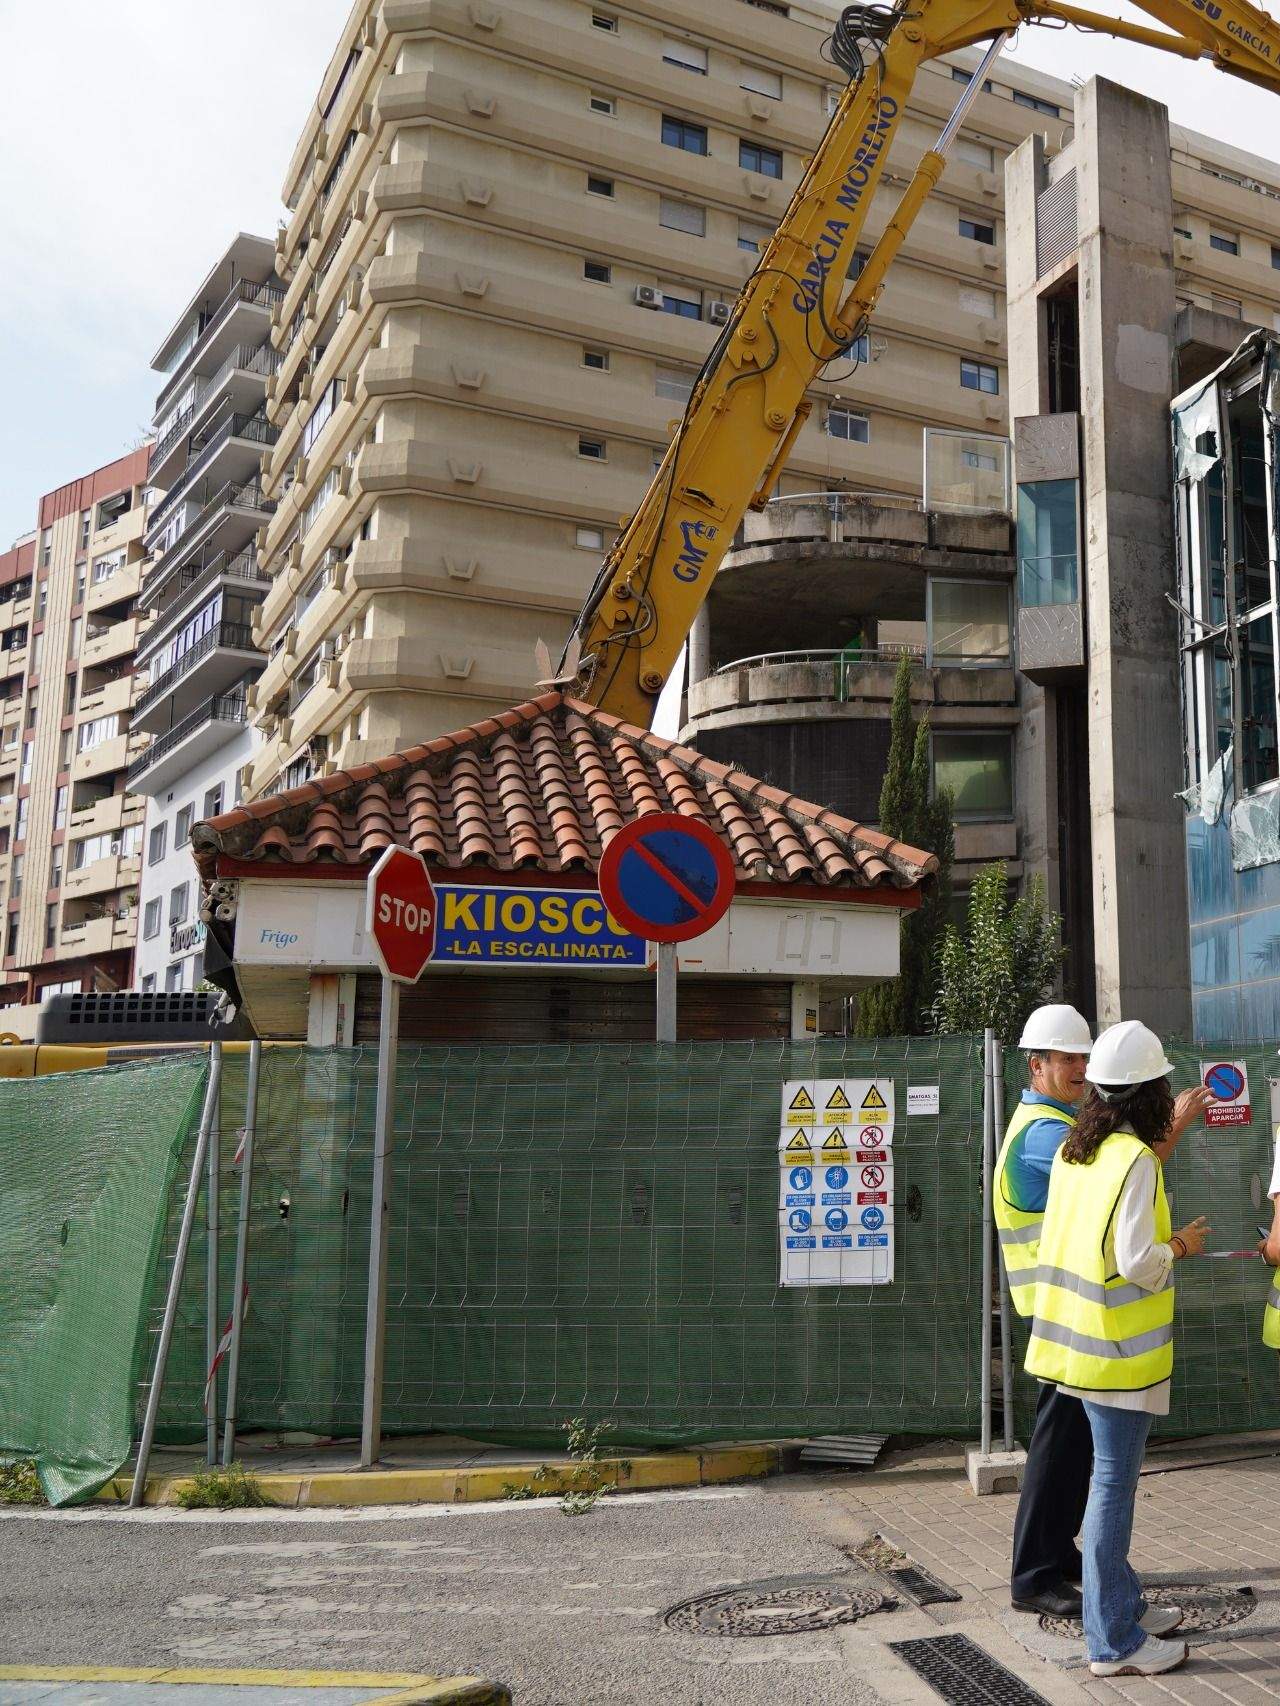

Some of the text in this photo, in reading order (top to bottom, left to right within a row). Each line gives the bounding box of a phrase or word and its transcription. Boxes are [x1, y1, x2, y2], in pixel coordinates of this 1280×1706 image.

[1186, 0, 1222, 20] SU
[1226, 20, 1271, 57] GARCIA
[793, 96, 898, 314] GARCIA MORENO
[672, 541, 709, 582] GM
[378, 893, 431, 935] STOP
[260, 928, 298, 948] Frigo
[1208, 1106, 1246, 1115] PROHIBIDO
[1211, 1113, 1244, 1122] APARCAR
